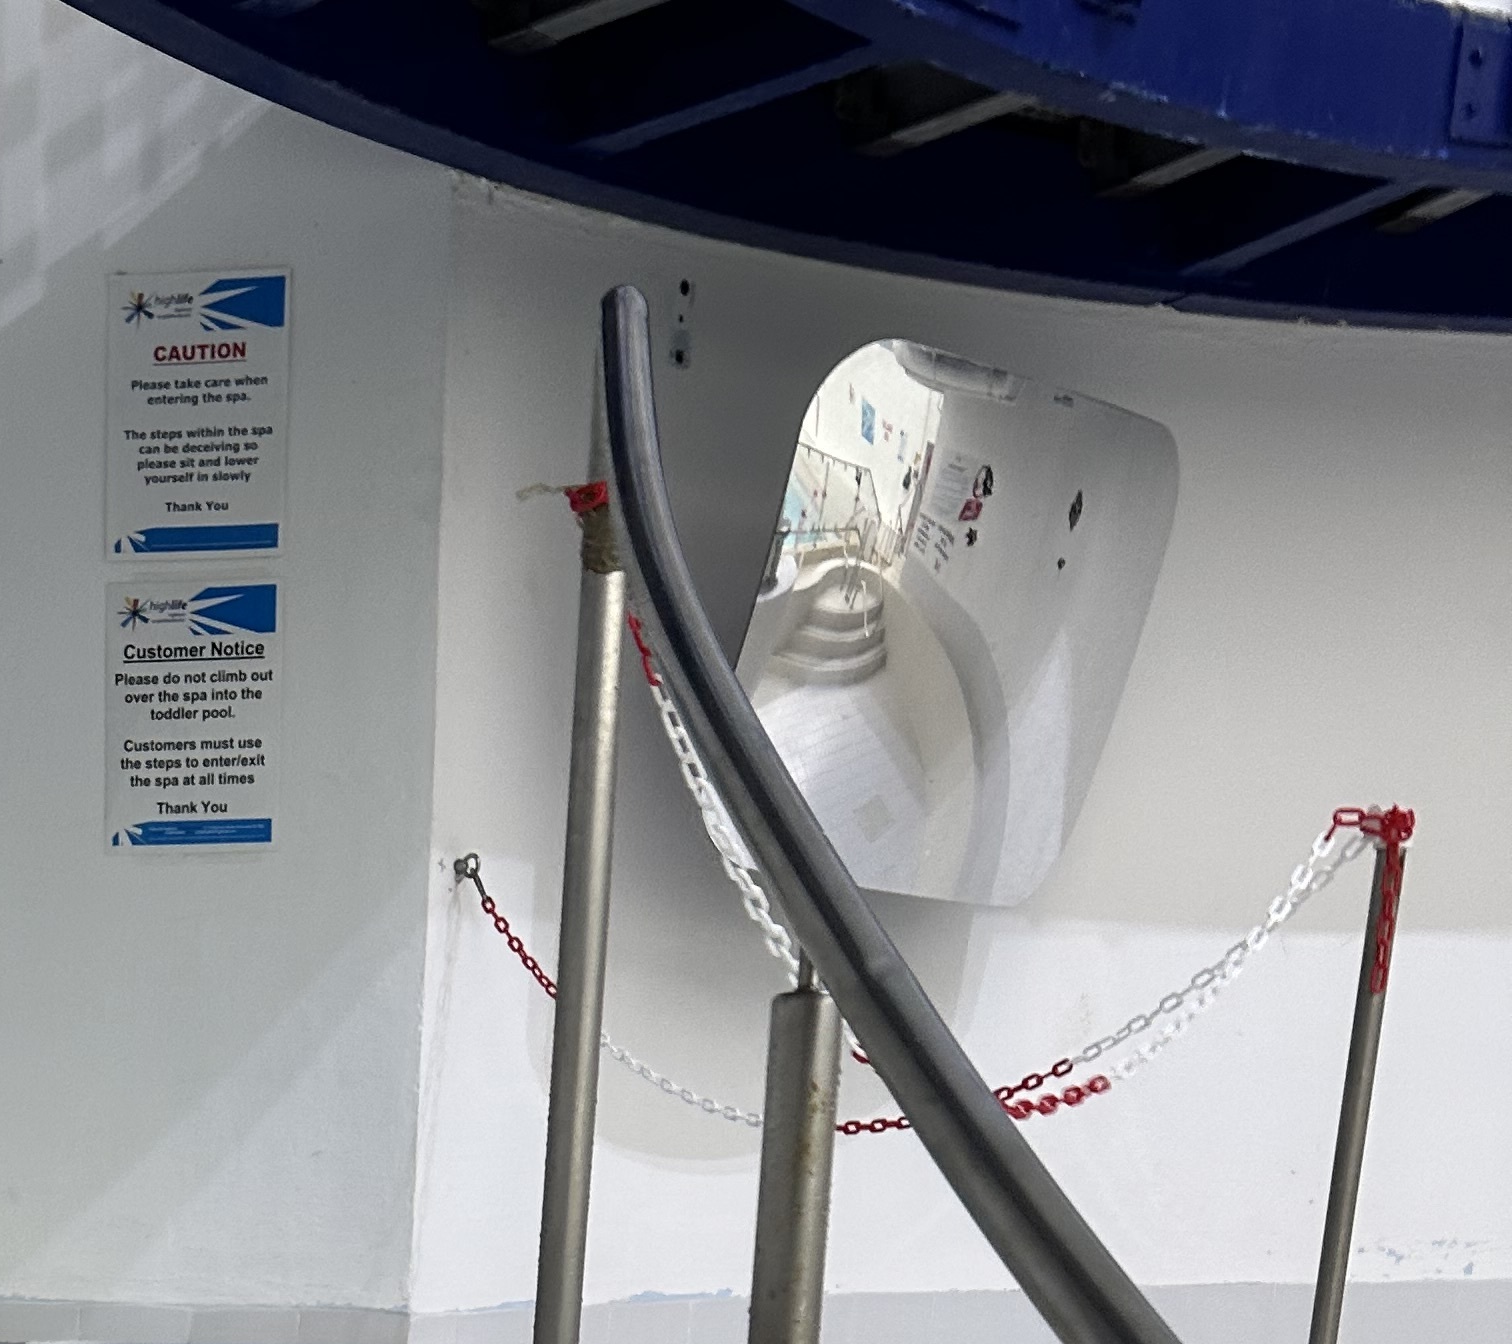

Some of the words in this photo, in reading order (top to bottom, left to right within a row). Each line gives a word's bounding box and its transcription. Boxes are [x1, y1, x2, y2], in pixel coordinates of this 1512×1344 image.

[154, 342, 246, 362] CAUTION
[132, 379, 171, 390] Please
[174, 377, 201, 389] take
[205, 378, 230, 388] care
[235, 374, 268, 385] when
[148, 393, 198, 406] entering
[203, 392, 222, 403] the
[124, 430, 146, 440] The
[150, 429, 182, 440] steps
[187, 426, 224, 438] within
[228, 426, 248, 436] the
[252, 425, 273, 436] spa
[139, 444, 160, 454] can
[164, 442, 178, 453] be
[182, 441, 240, 453] deceiving
[244, 441, 258, 451] so
[137, 457, 176, 471] please
[180, 456, 195, 468] sit
[198, 456, 220, 467] and
[225, 455, 259, 466] lower
[145, 472, 194, 485] yourself
[197, 471, 208, 482] in
[212, 470, 251, 482] slowly
[166, 501, 202, 512] Thank
[206, 500, 228, 511] You
[124, 643, 206, 660] Customer
[211, 640, 265, 657] Notice
[115, 672, 159, 686] Please
[163, 672, 180, 685] do
[185, 671, 206, 683] not
[210, 670, 247, 682] climb
[251, 669, 273, 681] out
[125, 691, 154, 703] over
[158, 690, 179, 702] the
[183, 690, 207, 705] spa
[212, 689, 237, 701] into
[241, 686, 262, 699] the
[150, 707, 198, 721] toddler
[202, 706, 235, 721] pool.
[124, 738, 196, 752] Customers
[201, 738, 234, 750] must
[238, 738, 262, 749] use
[121, 757, 141, 770] the
[145, 756, 181, 770] steps
[186, 755, 198, 768] to
[203, 753, 265, 767] enter/exit
[130, 774, 150, 787] the
[155, 775, 179, 789] spa
[183, 773, 194, 786] at
[198, 772, 214, 784] all
[219, 771, 255, 784] times
[157, 801, 197, 814] Thank
[202, 800, 228, 813] You
